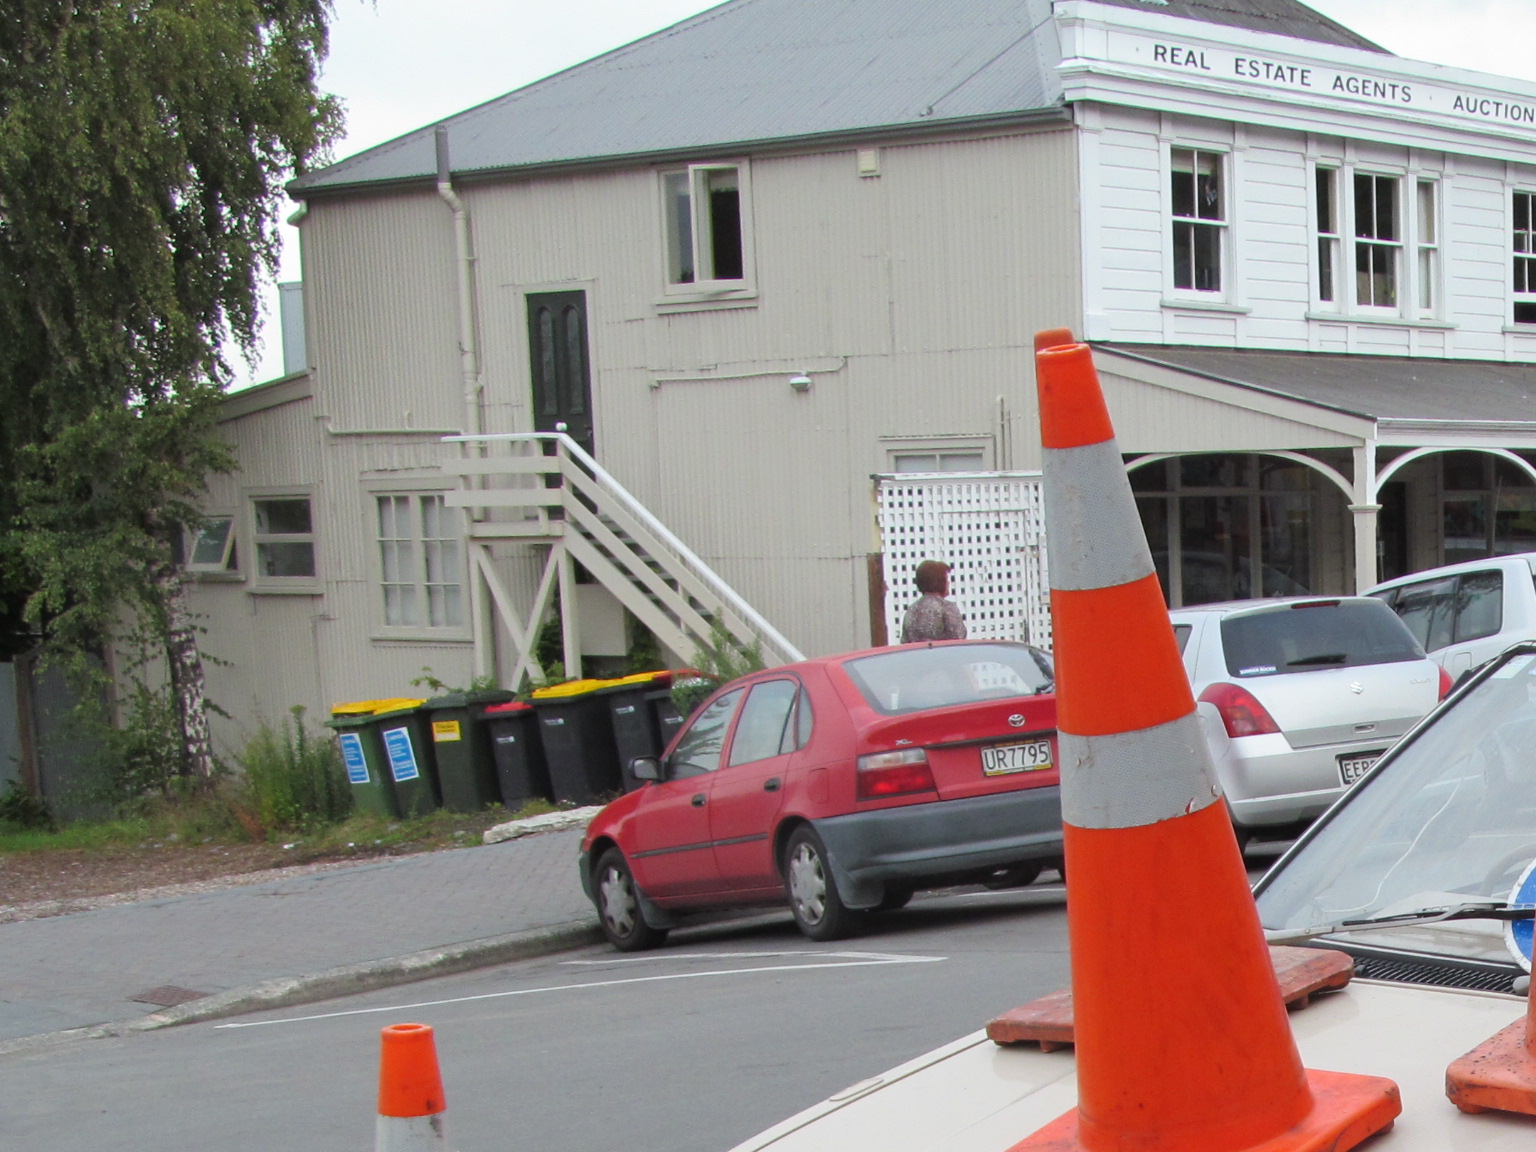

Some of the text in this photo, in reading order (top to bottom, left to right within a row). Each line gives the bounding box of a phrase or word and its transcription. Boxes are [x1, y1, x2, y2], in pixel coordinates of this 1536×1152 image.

[1153, 43, 1212, 71] REAL
[1234, 57, 1312, 87] ESTATE
[1332, 75, 1413, 103] AGENTS
[984, 743, 1049, 770] UR7795
